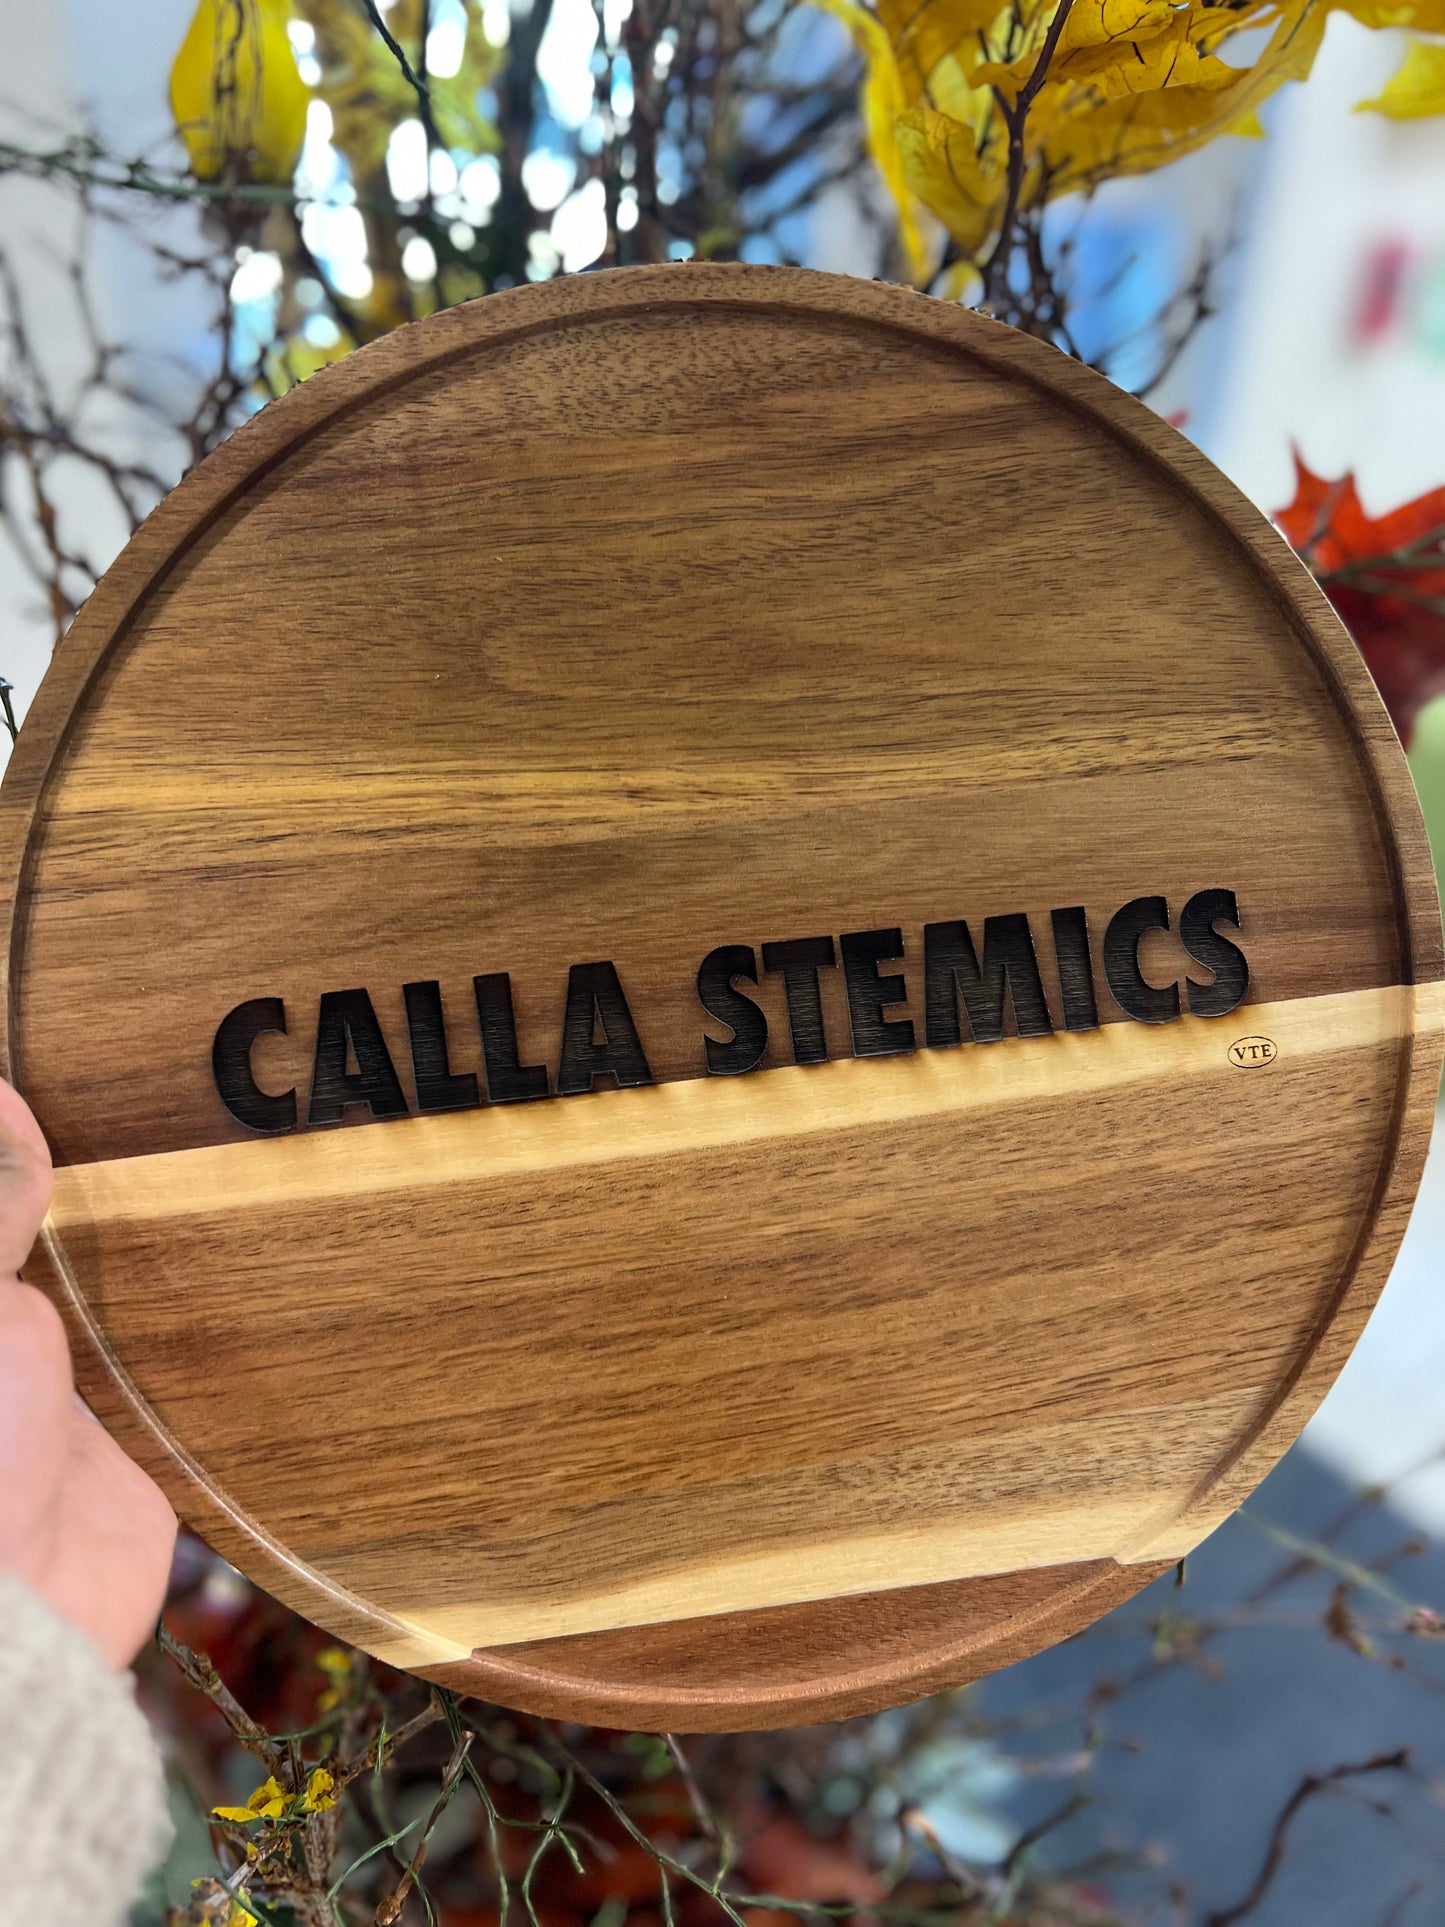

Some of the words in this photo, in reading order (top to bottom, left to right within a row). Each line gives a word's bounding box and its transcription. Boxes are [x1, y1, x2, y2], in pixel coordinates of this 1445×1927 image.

[212, 961, 655, 1133] CALLA
[697, 888, 1250, 1075] STEMICS
[1233, 1043, 1272, 1061] VTE
